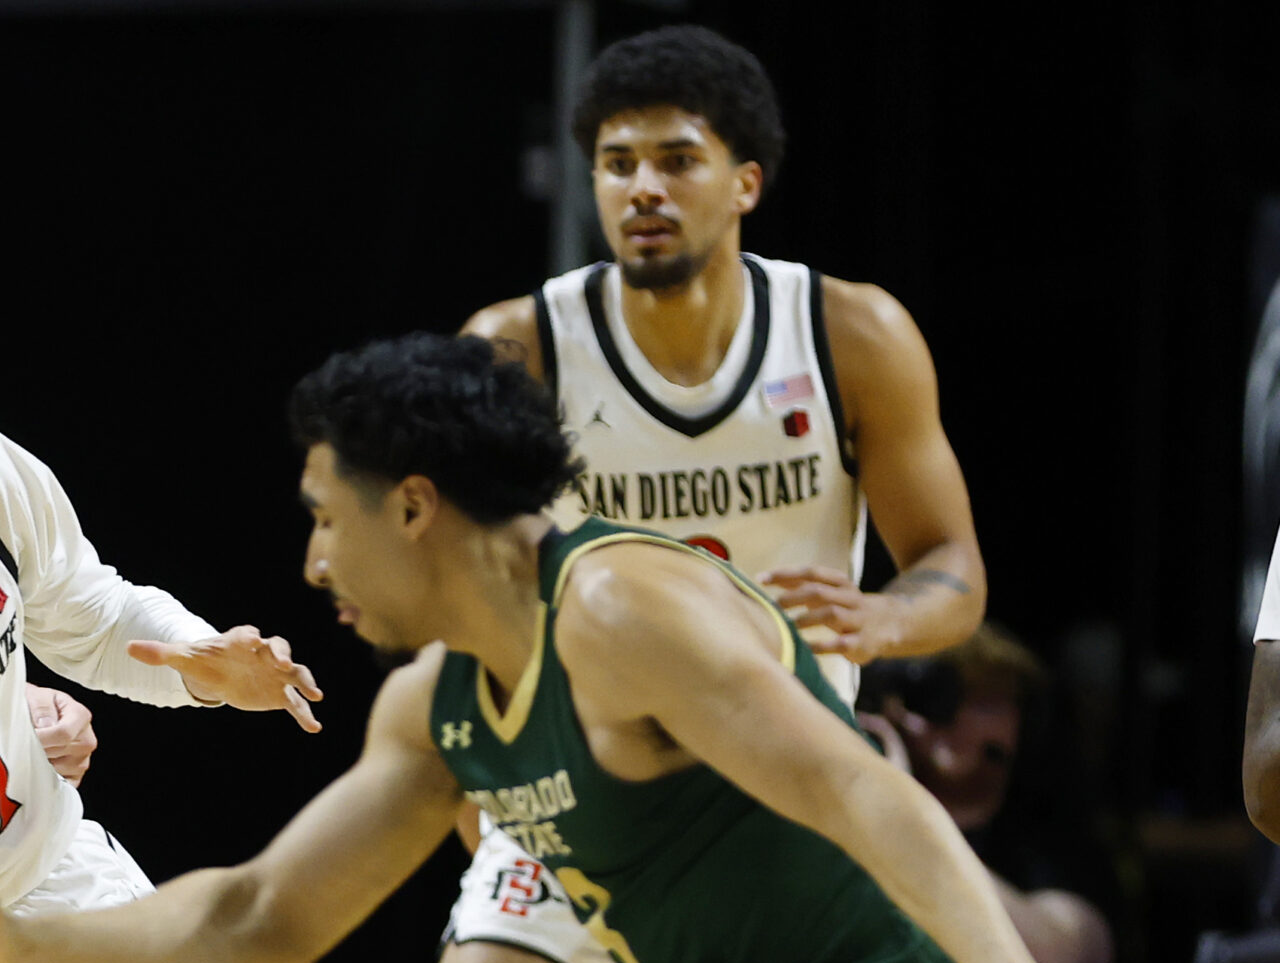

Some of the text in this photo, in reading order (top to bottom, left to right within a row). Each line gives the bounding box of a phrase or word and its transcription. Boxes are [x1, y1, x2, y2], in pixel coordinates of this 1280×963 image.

[577, 453, 822, 520] SAN DIEGO STATE
[464, 768, 578, 823] ORADO
